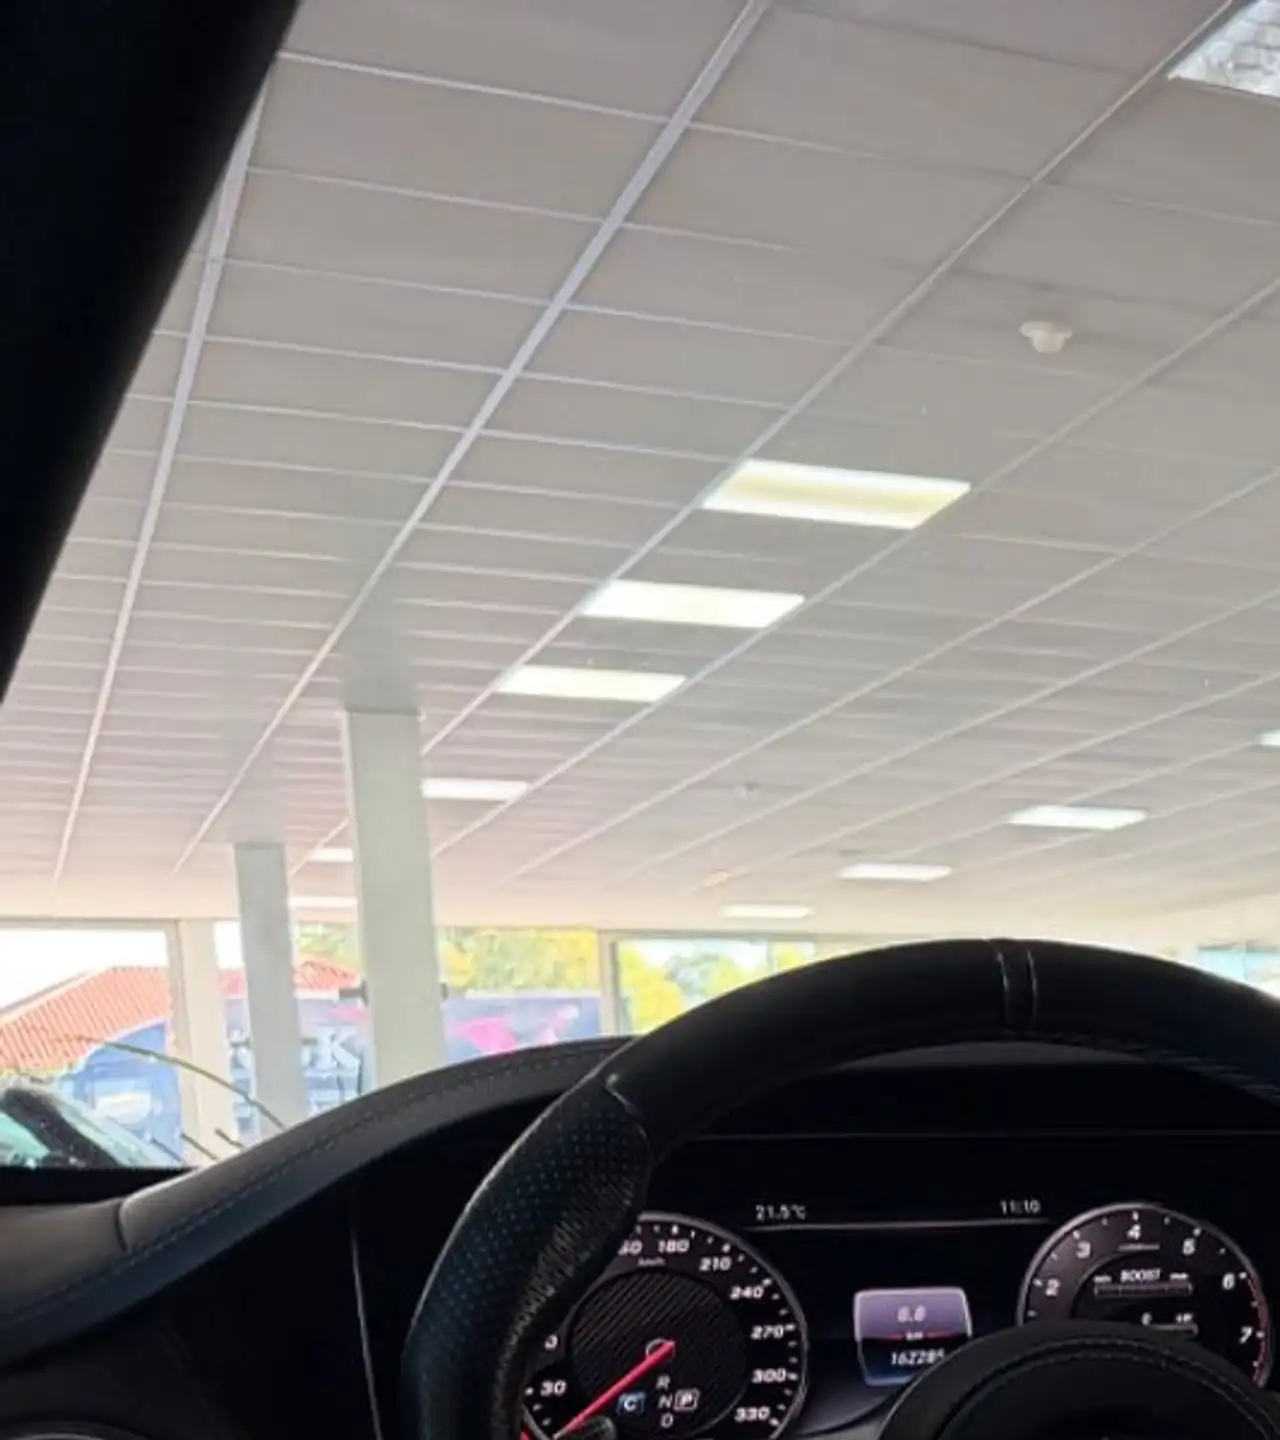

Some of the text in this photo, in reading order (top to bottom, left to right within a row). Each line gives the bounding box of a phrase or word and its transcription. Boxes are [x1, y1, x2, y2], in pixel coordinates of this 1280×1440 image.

[1126, 1222, 1142, 1240] 4
[657, 1238, 691, 1254] 180
[1075, 1240, 1091, 1259] 3
[1182, 1237, 1197, 1256] 5
[699, 1256, 733, 1272] 210
[1044, 1278, 1060, 1298] 2
[1221, 1272, 1236, 1291] 6
[729, 1285, 764, 1300] 240
[750, 1324, 785, 1341] 270
[1238, 1325, 1254, 1345] 7
[750, 1367, 788, 1384] 300
[539, 1379, 567, 1396] 30
[734, 1405, 772, 1421] 330
